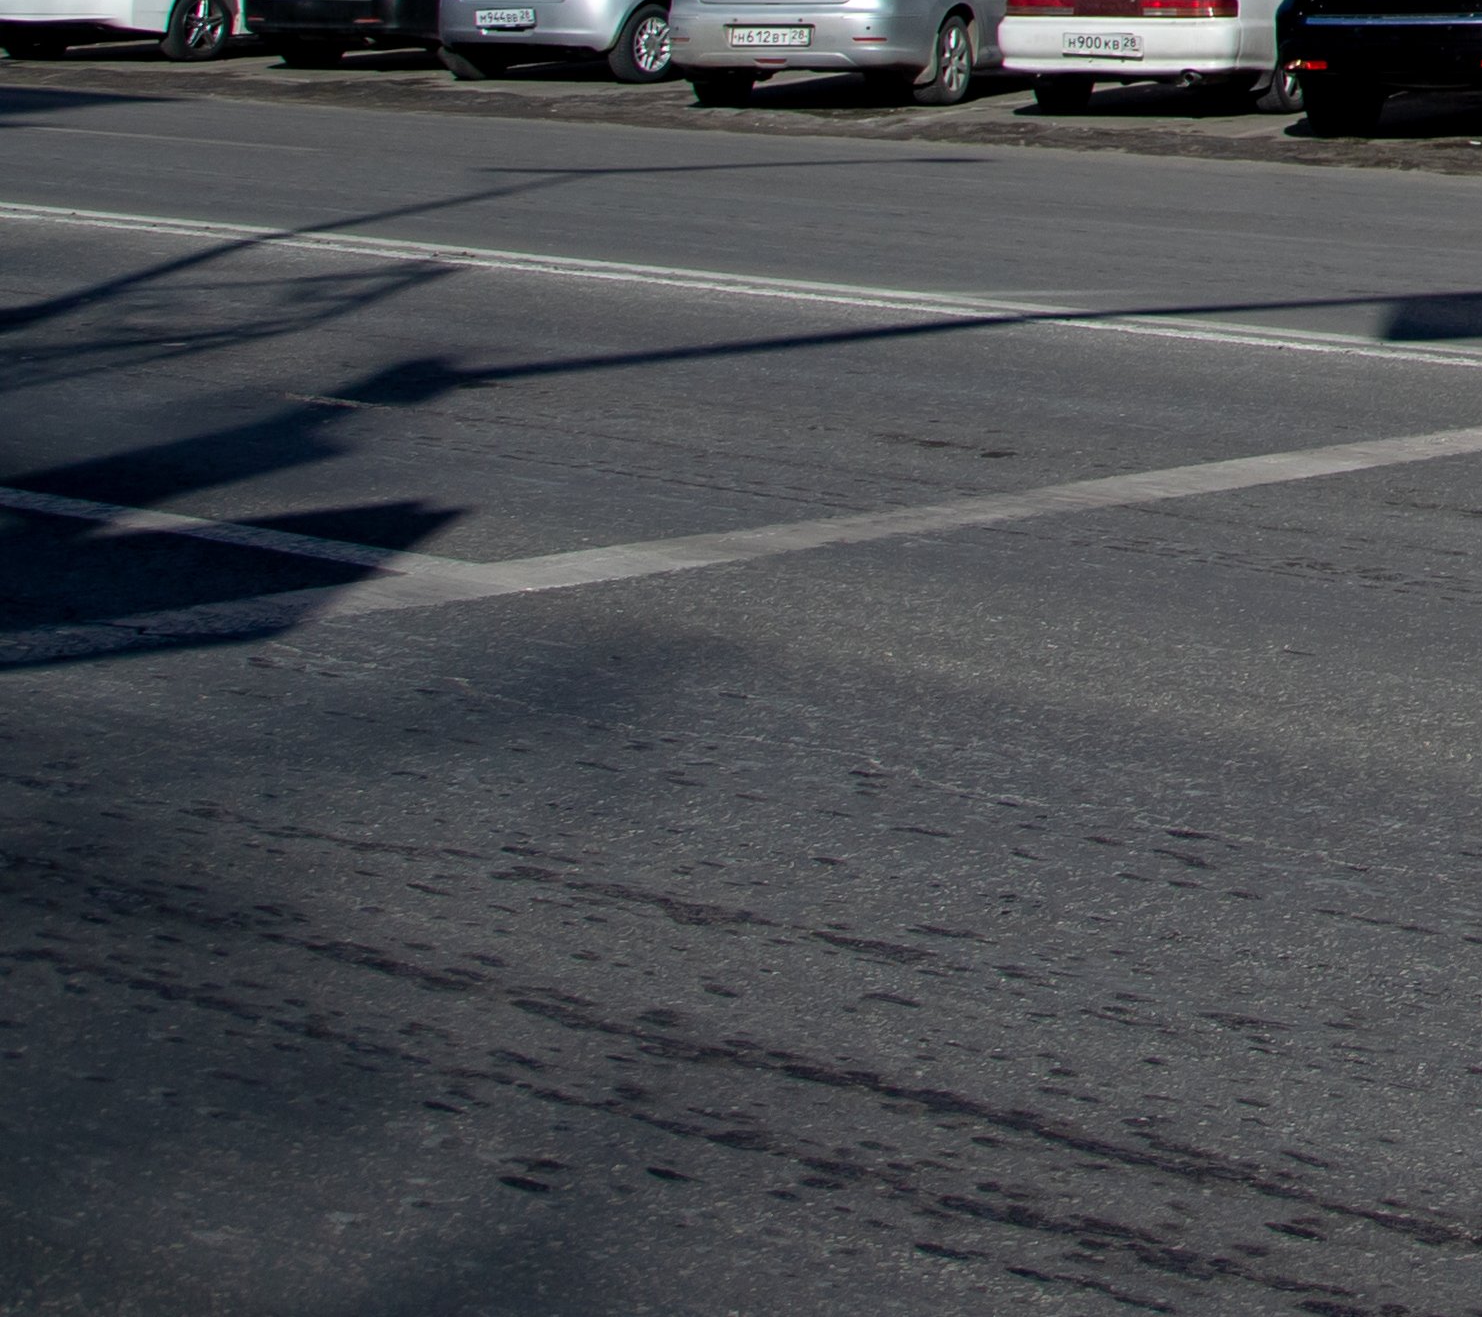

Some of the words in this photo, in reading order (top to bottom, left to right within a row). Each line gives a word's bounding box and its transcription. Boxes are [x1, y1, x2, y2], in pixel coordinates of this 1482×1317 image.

[736, 27, 789, 44] Н612ВТ
[791, 28, 806, 41] 28
[1068, 36, 1120, 51] Н900КВ
[1123, 37, 1137, 48] 28
